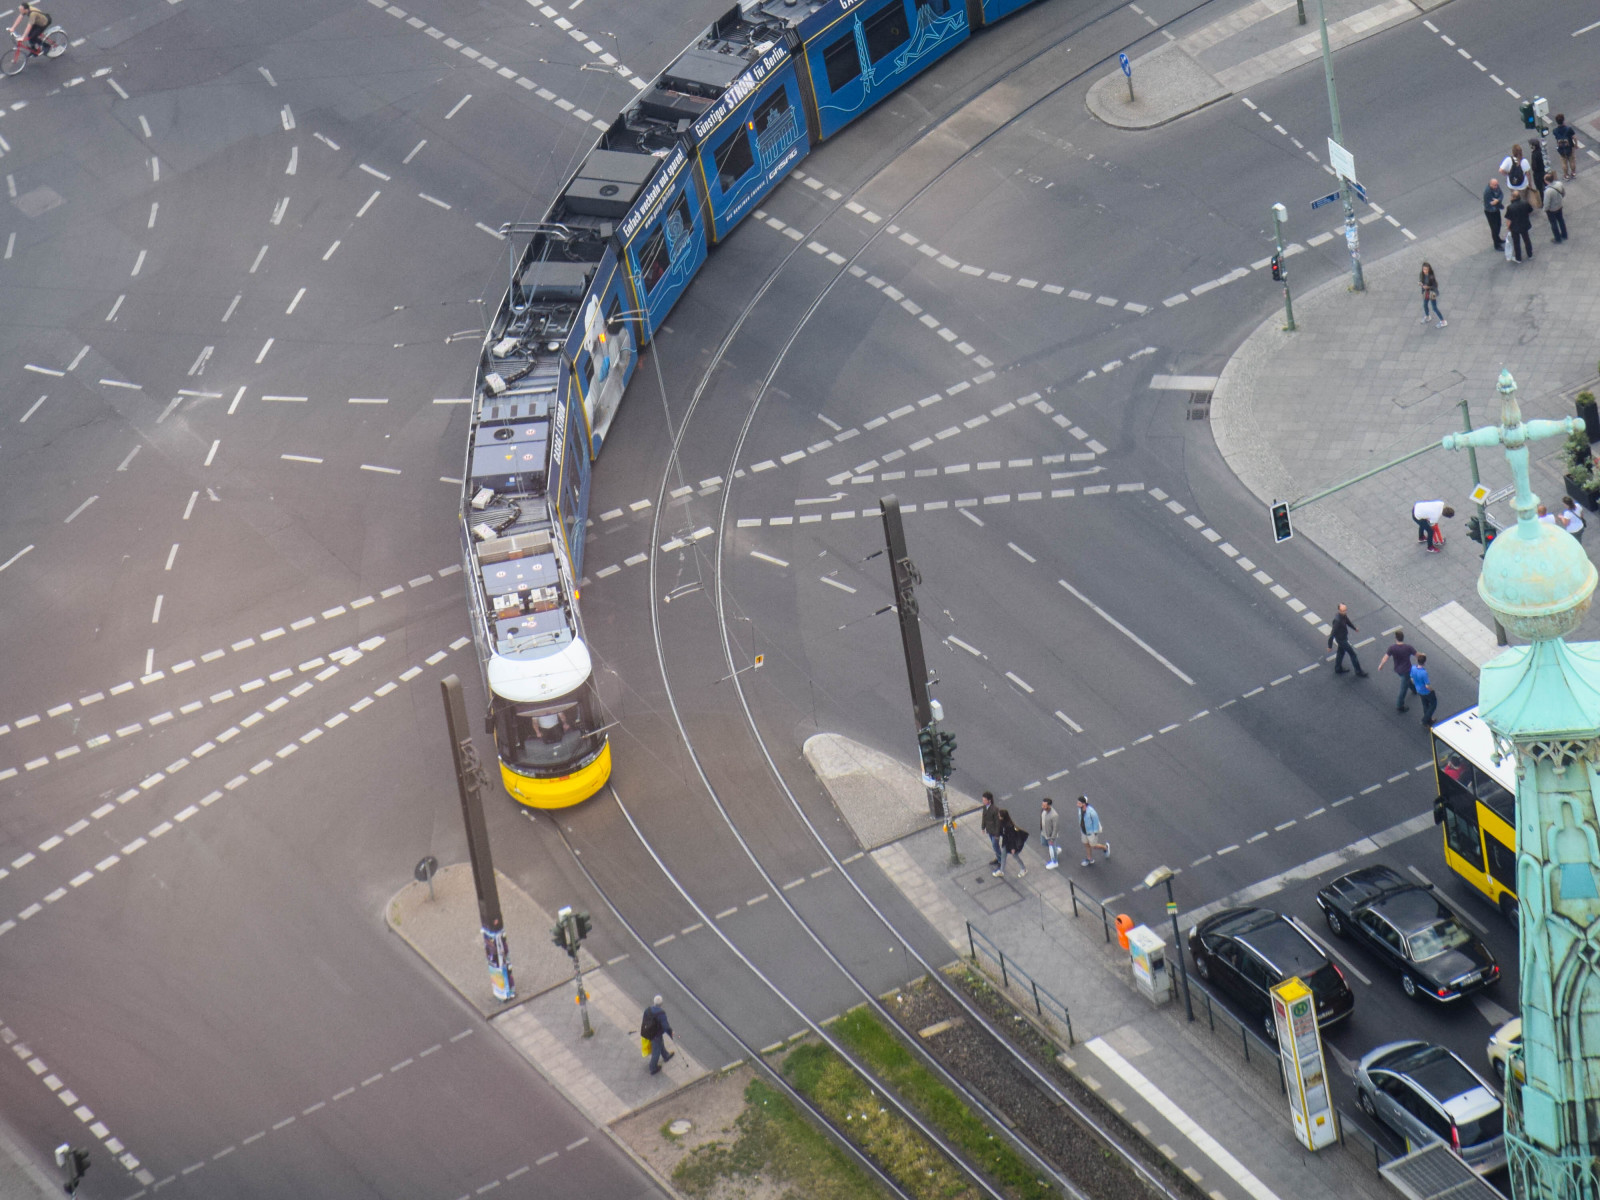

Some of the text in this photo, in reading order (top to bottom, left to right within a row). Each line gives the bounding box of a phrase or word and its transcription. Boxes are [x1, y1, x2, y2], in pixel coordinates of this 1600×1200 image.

[694, 46, 787, 138] Günstiger STROM für Berlin.
[622, 147, 685, 238] Einfach wechseln und sparen!
[769, 147, 798, 180] GASAG
